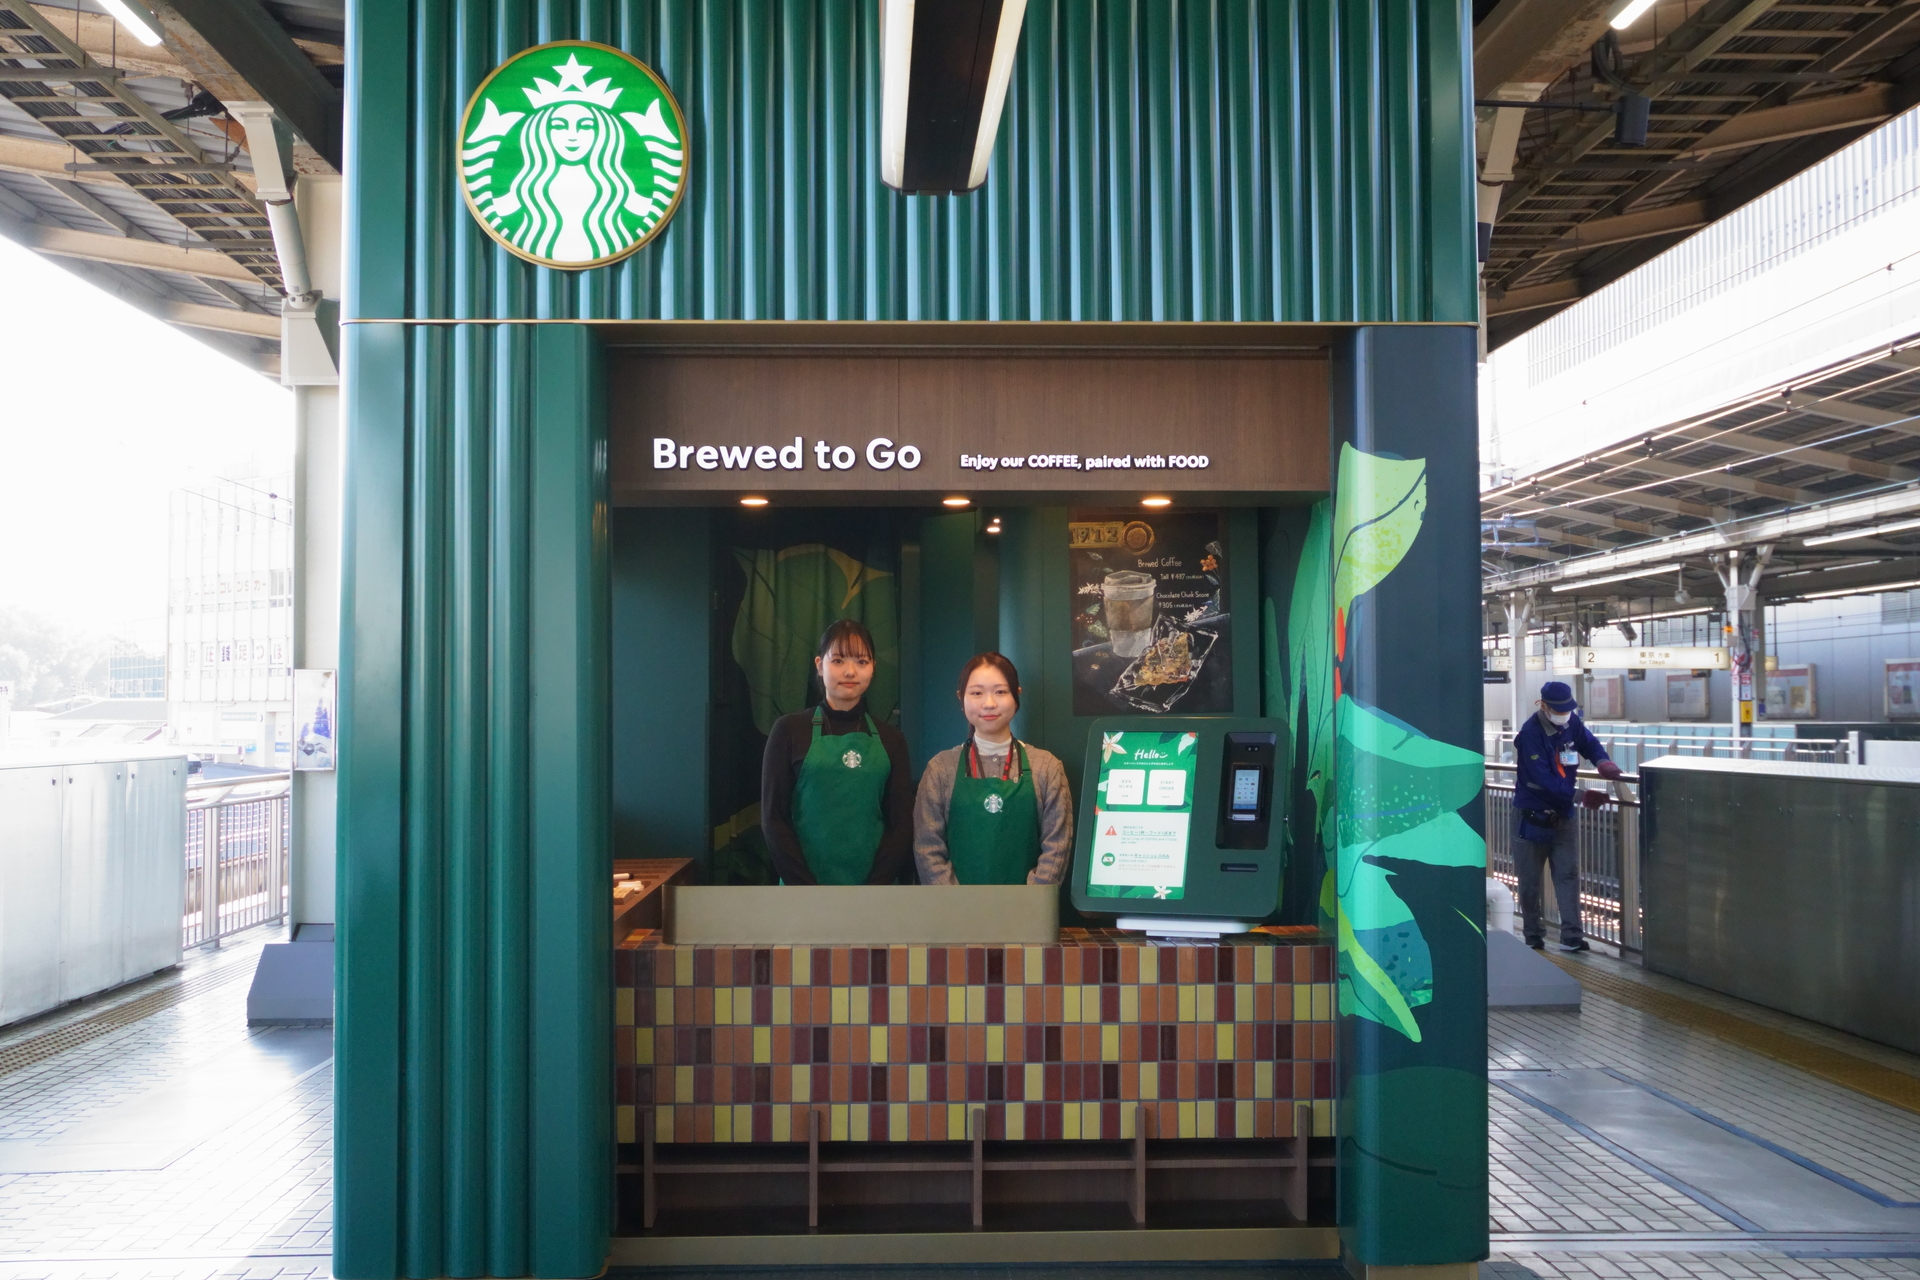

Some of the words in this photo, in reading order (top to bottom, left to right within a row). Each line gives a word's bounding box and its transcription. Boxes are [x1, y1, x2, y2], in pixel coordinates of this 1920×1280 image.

[653, 436, 803, 469] Brewed
[814, 440, 856, 469] to
[866, 437, 921, 469] Go
[960, 454, 998, 470] Enjoy
[1000, 457, 1025, 468] our
[1027, 454, 1082, 470] COFFEE,
[1085, 454, 1131, 470] paired
[1134, 454, 1165, 468] with
[1168, 455, 1209, 468] FOOD
[1137, 558, 1159, 568] Brewed
[1160, 557, 1182, 567] Coffee
[1587, 652, 1595, 663] 2
[1639, 651, 1655, 659] 東京
[1714, 652, 1720, 663] 1
[1134, 749, 1160, 760] Hello
